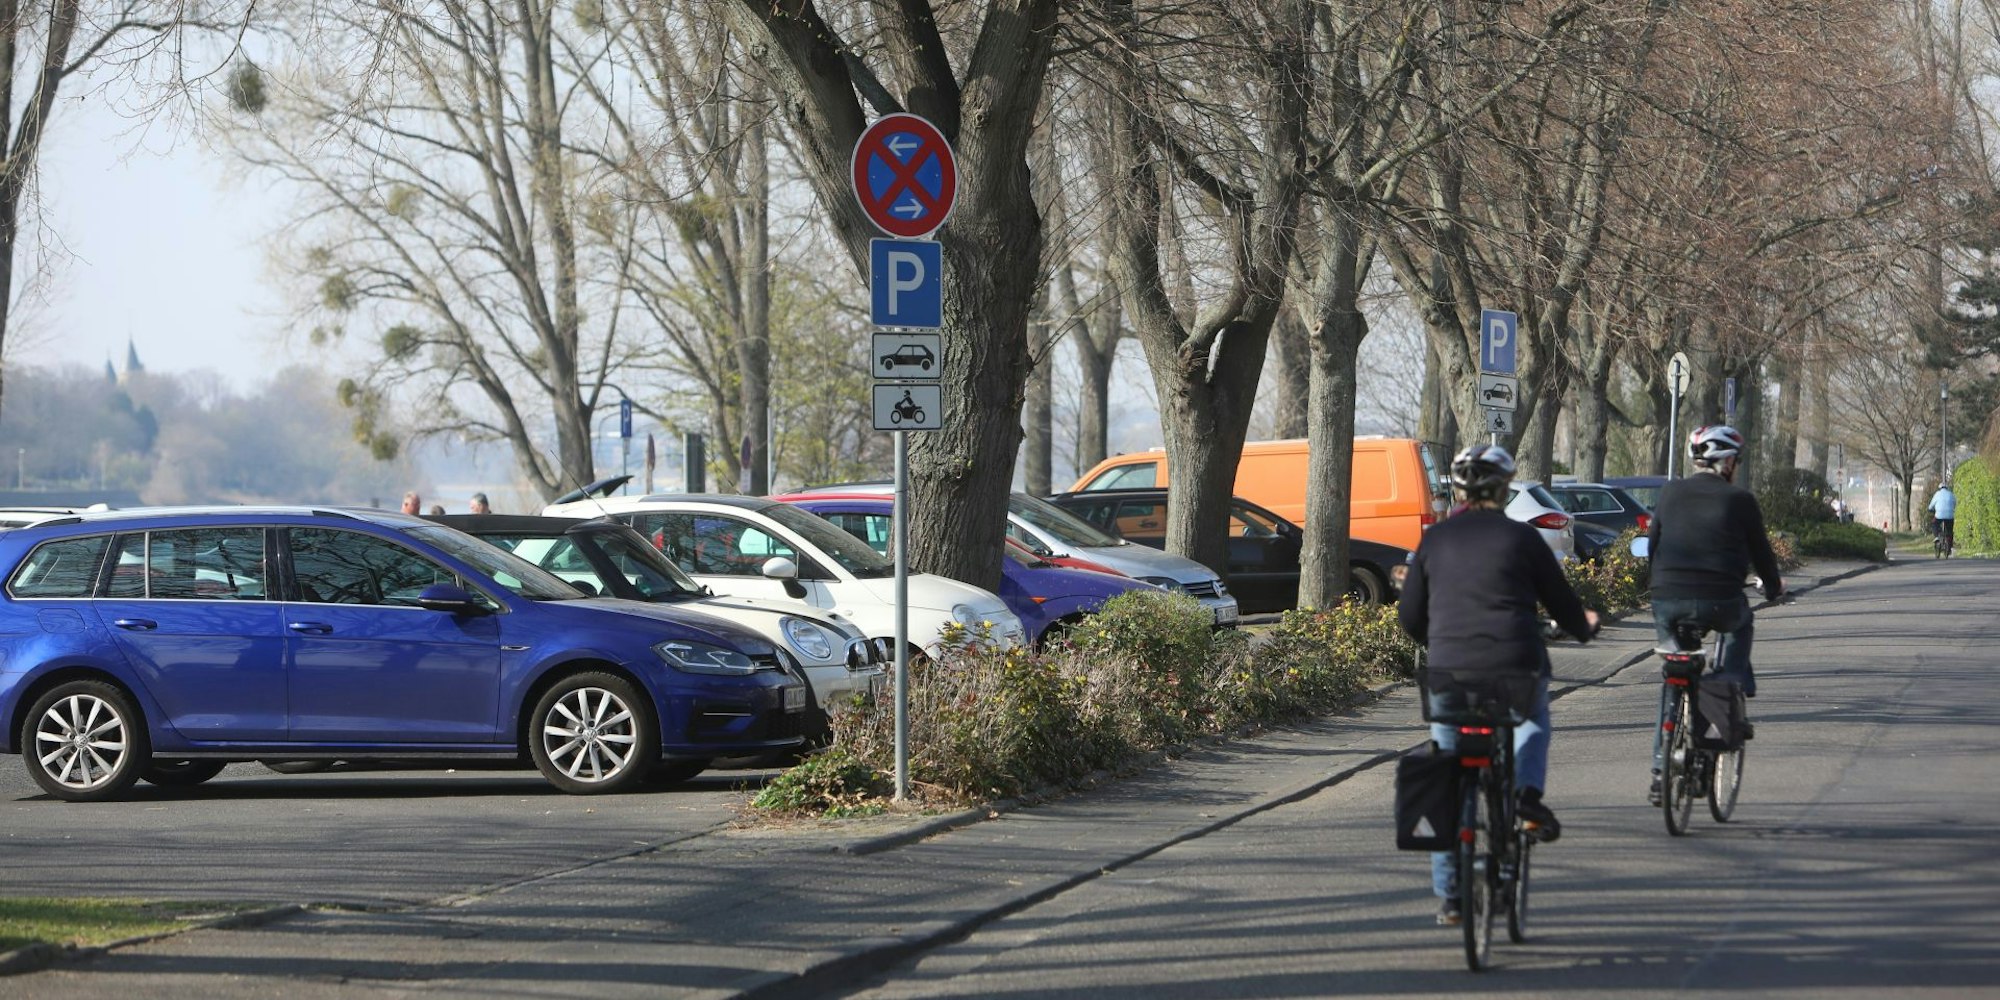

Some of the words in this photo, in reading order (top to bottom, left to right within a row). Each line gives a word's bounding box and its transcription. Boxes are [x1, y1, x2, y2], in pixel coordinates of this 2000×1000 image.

[888, 251, 925, 316] P
[1489, 318, 1508, 365] P
[1727, 383, 1733, 411] P
[622, 404, 630, 434] P
